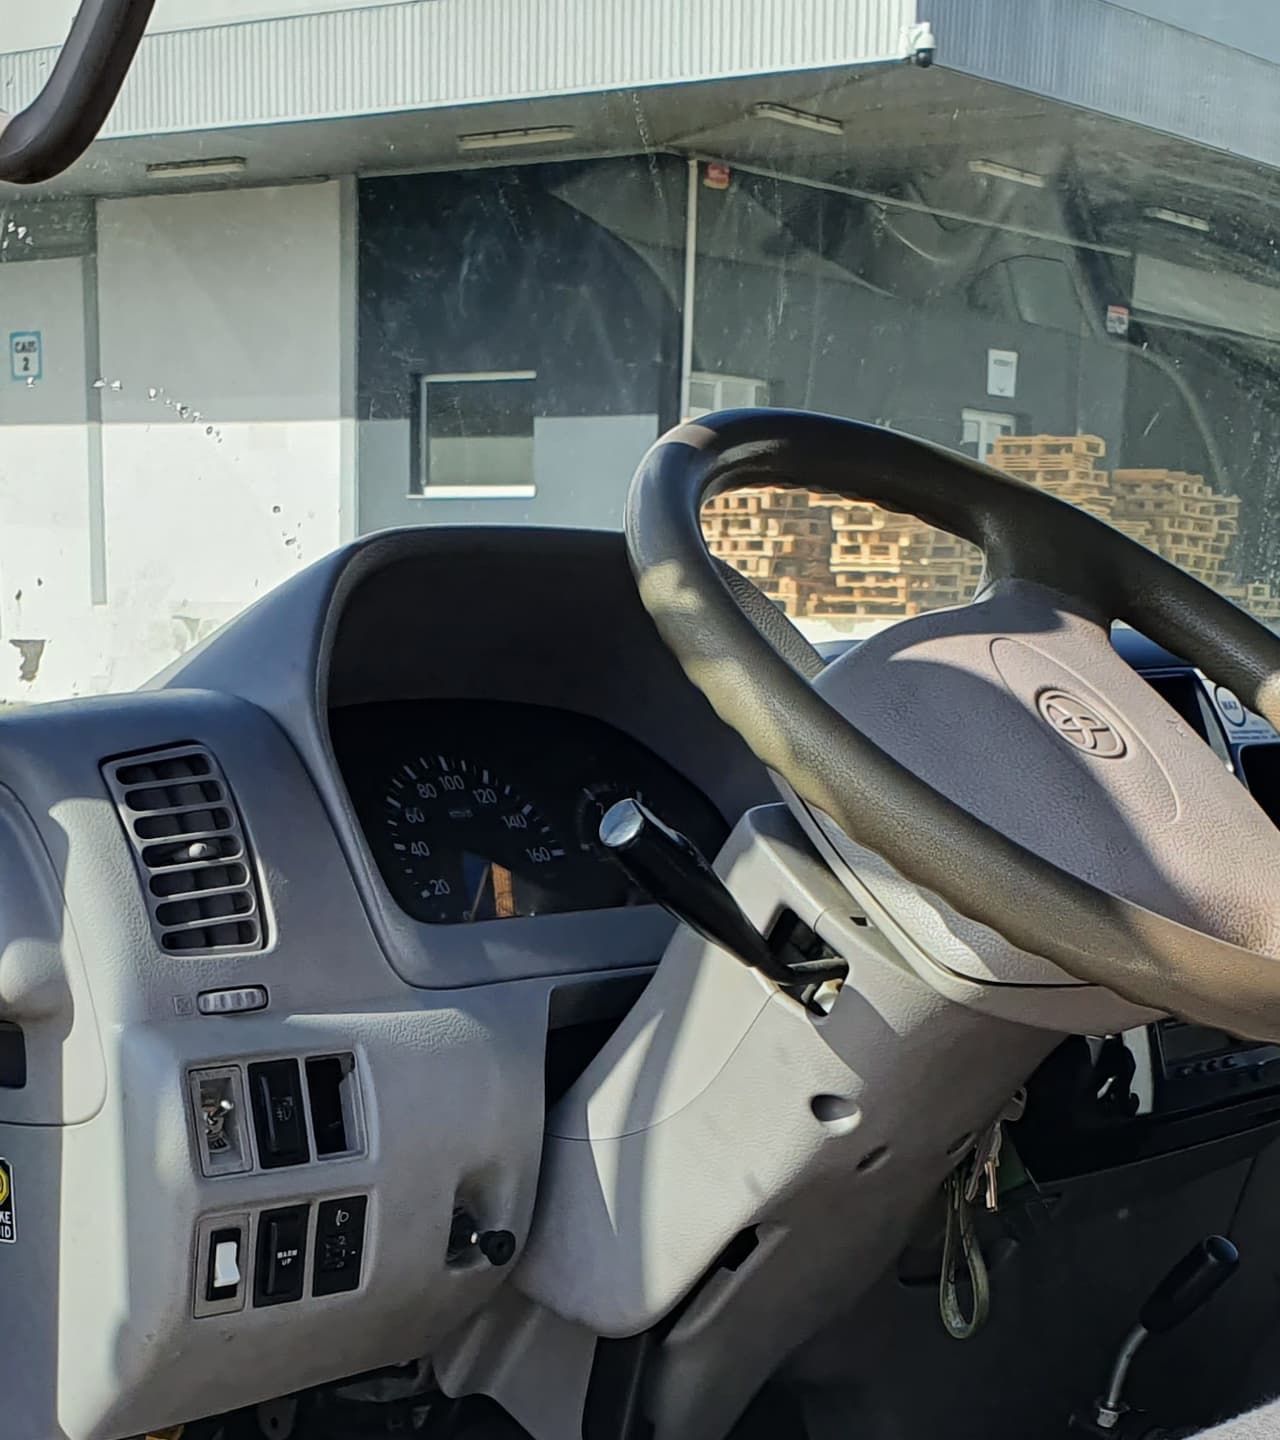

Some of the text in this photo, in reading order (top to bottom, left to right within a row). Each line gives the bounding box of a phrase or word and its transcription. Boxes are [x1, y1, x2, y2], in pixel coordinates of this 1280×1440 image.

[23, 356, 30, 371] 2
[417, 783, 437, 799] 80
[438, 775, 465, 791] 100
[472, 788, 497, 804] 120
[405, 807, 425, 824] 60
[501, 813, 528, 830] 140
[410, 840, 430, 857] 40
[526, 846, 551, 863] 160
[429, 878, 450, 896] 20
